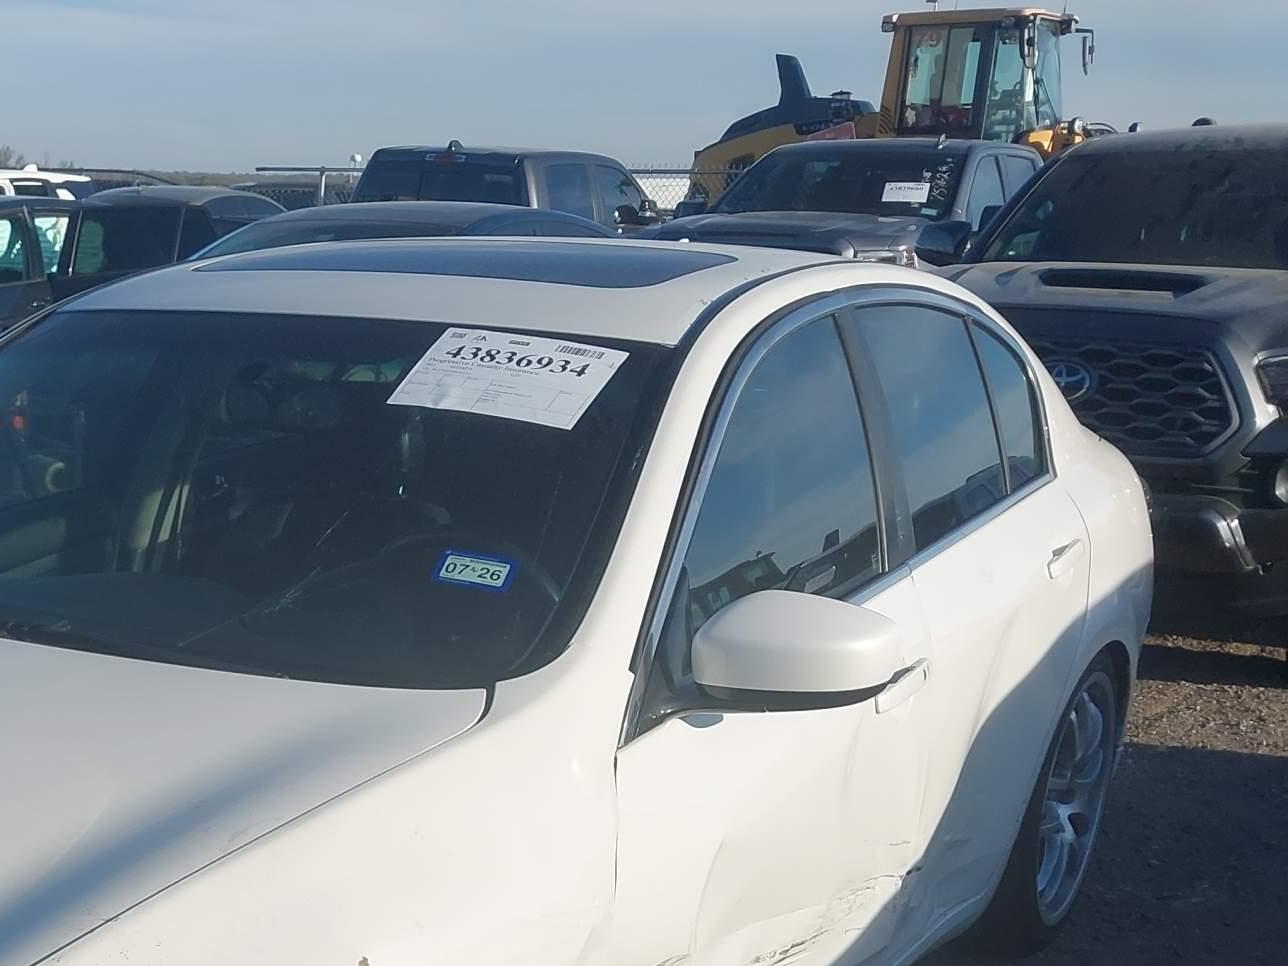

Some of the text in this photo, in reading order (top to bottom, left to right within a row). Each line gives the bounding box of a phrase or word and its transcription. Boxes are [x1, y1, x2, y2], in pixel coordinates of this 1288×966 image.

[428, 357, 470, 367] Progressive
[471, 360, 503, 371] Casualty
[445, 345, 591, 377] 43836934
[445, 562, 470, 575] 07
[476, 567, 503, 581] 26
